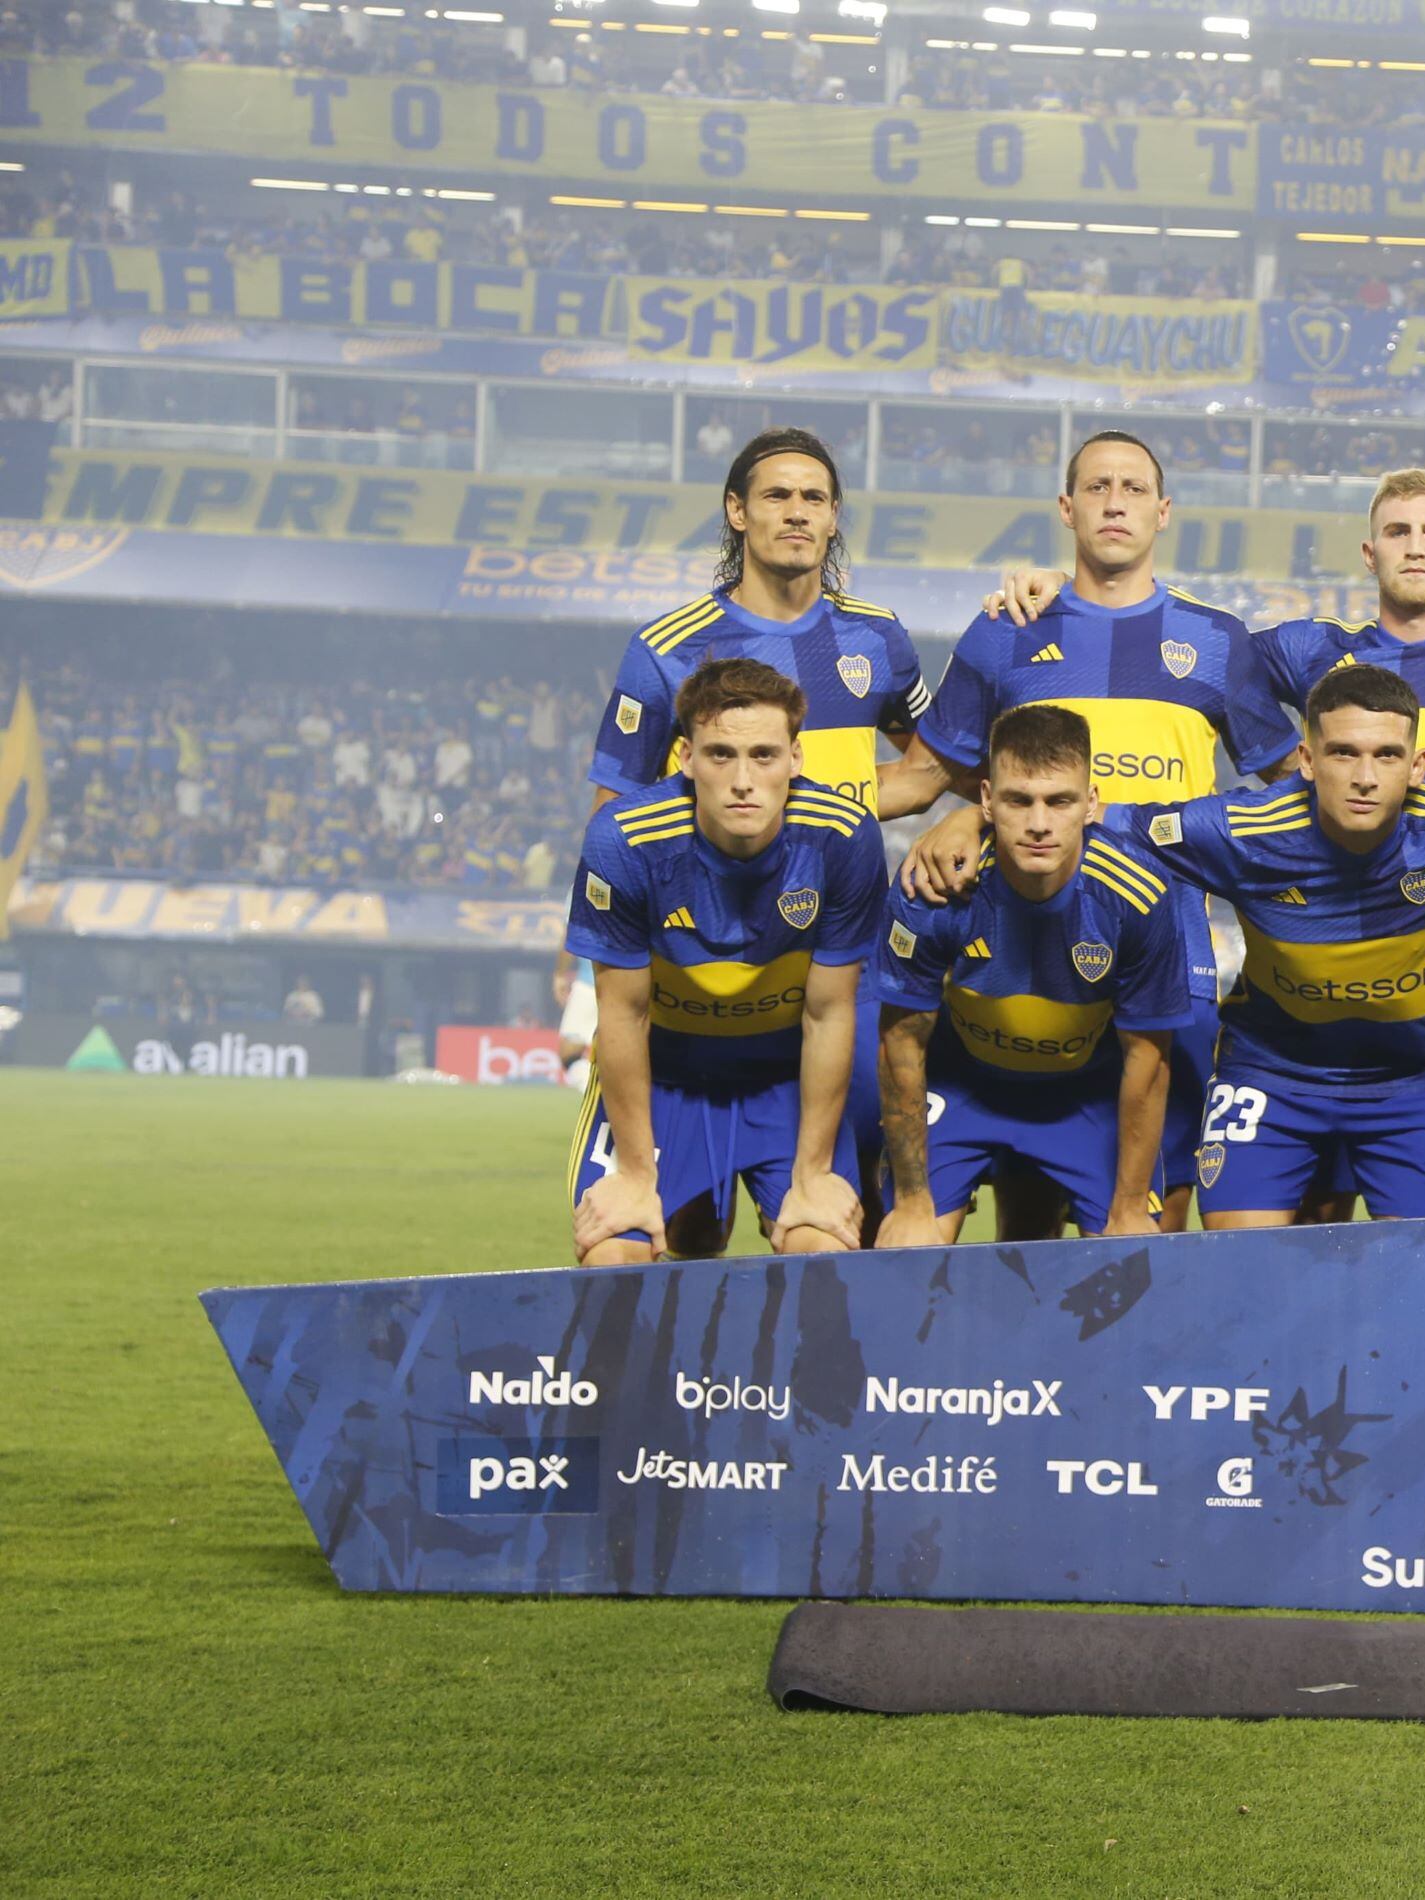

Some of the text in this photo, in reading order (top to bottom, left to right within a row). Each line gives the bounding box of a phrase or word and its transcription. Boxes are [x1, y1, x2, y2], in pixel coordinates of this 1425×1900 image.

[292, 78, 748, 178] TODOS
[280, 260, 604, 336] BOCA
[842, 668, 869, 679] CABJ
[1165, 651, 1193, 663] CABJ
[1092, 752, 1184, 783] sson
[784, 900, 814, 913] CABJ
[1077, 956, 1106, 966] CABJ
[653, 982, 804, 1017] betsso
[1203, 1084, 1267, 1142] 23
[469, 1356, 598, 1406] Naldo
[1143, 1386, 1270, 1421] YPF
[469, 1454, 570, 1499] pax
[616, 1447, 788, 1490] JetSMART
[836, 1454, 997, 1494] Medifé
[1047, 1461, 1158, 1495] TCL
[1205, 1497, 1262, 1508] GATORADE
